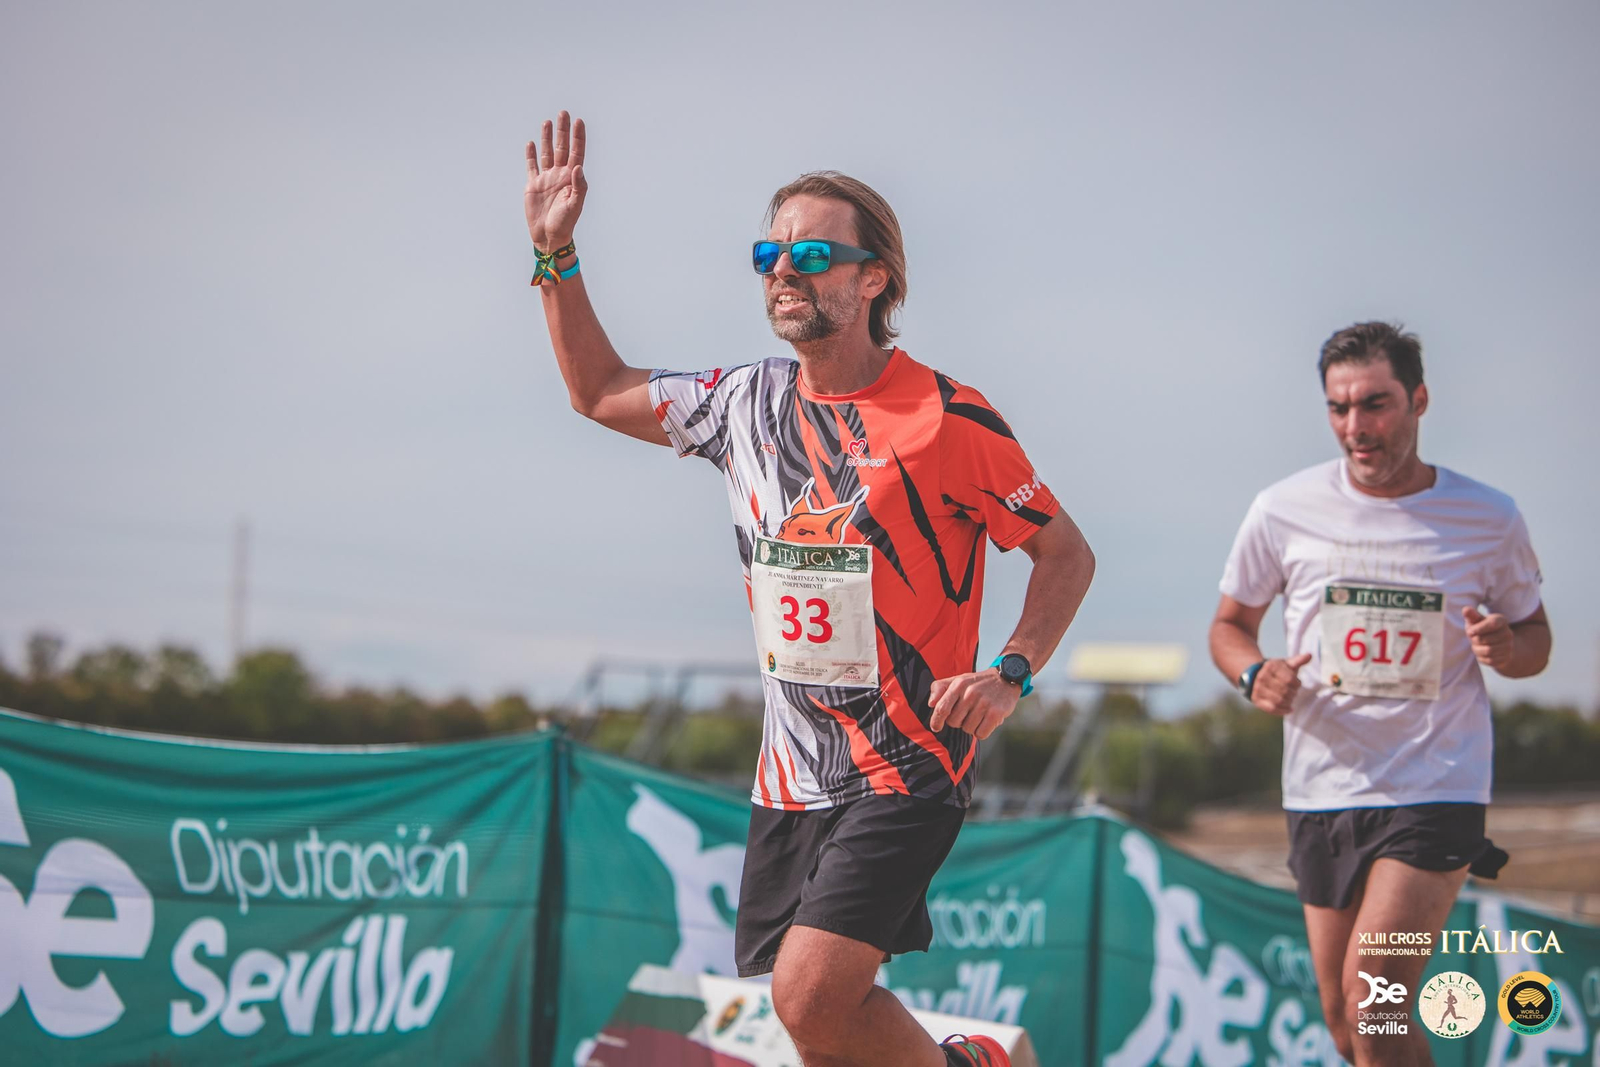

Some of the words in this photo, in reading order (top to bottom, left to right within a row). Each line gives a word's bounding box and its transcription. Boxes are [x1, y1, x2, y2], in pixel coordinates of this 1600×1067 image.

[778, 547, 836, 566] ITÁLICA
[782, 581, 823, 589] INDEPENDIENTE
[786, 574, 814, 582] MARTINEZ
[780, 595, 833, 644] 33
[1344, 628, 1422, 666] 617
[170, 817, 469, 914] Diputación
[169, 915, 455, 1037] Sevilla
